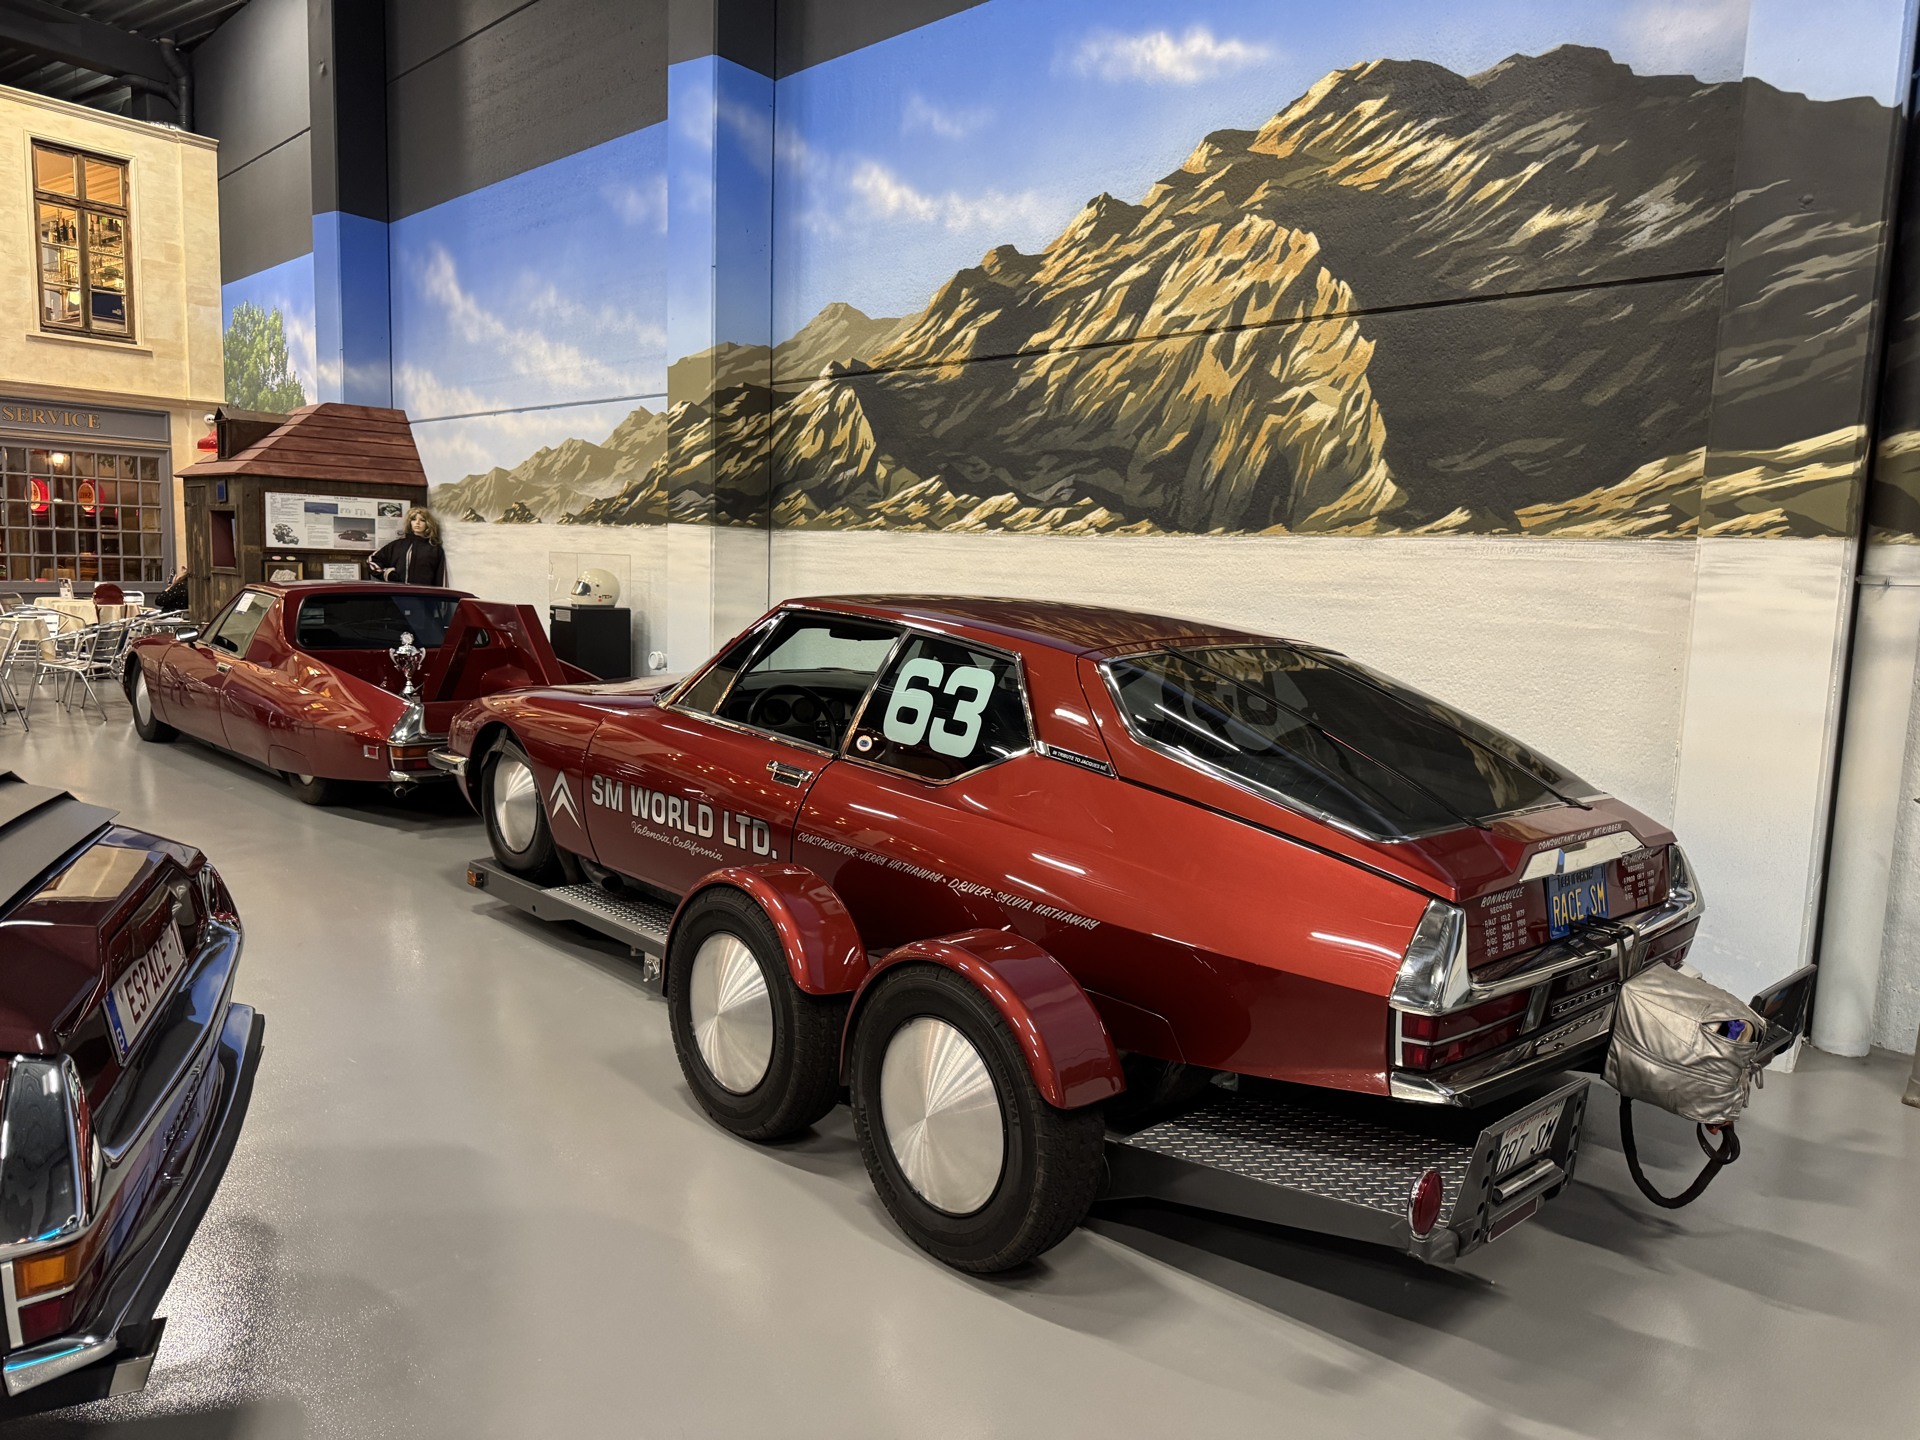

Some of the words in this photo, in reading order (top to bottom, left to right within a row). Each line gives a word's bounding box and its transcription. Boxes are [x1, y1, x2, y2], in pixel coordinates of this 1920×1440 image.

[2, 406, 101, 429] SERVICE
[883, 657, 996, 759] 63
[591, 774, 624, 813] SM
[630, 784, 714, 840] WORLD
[723, 810, 779, 860] LTD.
[631, 820, 672, 846] Valencia,
[672, 835, 724, 862] California
[859, 851, 887, 866] JERRY
[887, 859, 943, 883] HATHAWAY
[947, 878, 994, 899] DRIVER:
[993, 891, 1034, 912] SYLVIA
[1032, 903, 1101, 931] HATHAWAY
[1481, 886, 1525, 908] BONNEVILLE
[1489, 902, 1513, 915] RECORDS
[1552, 888, 1585, 928] RACE
[1589, 881, 1606, 915] SM
[116, 1027, 125, 1048] B
[1529, 1114, 1559, 1156] SM
